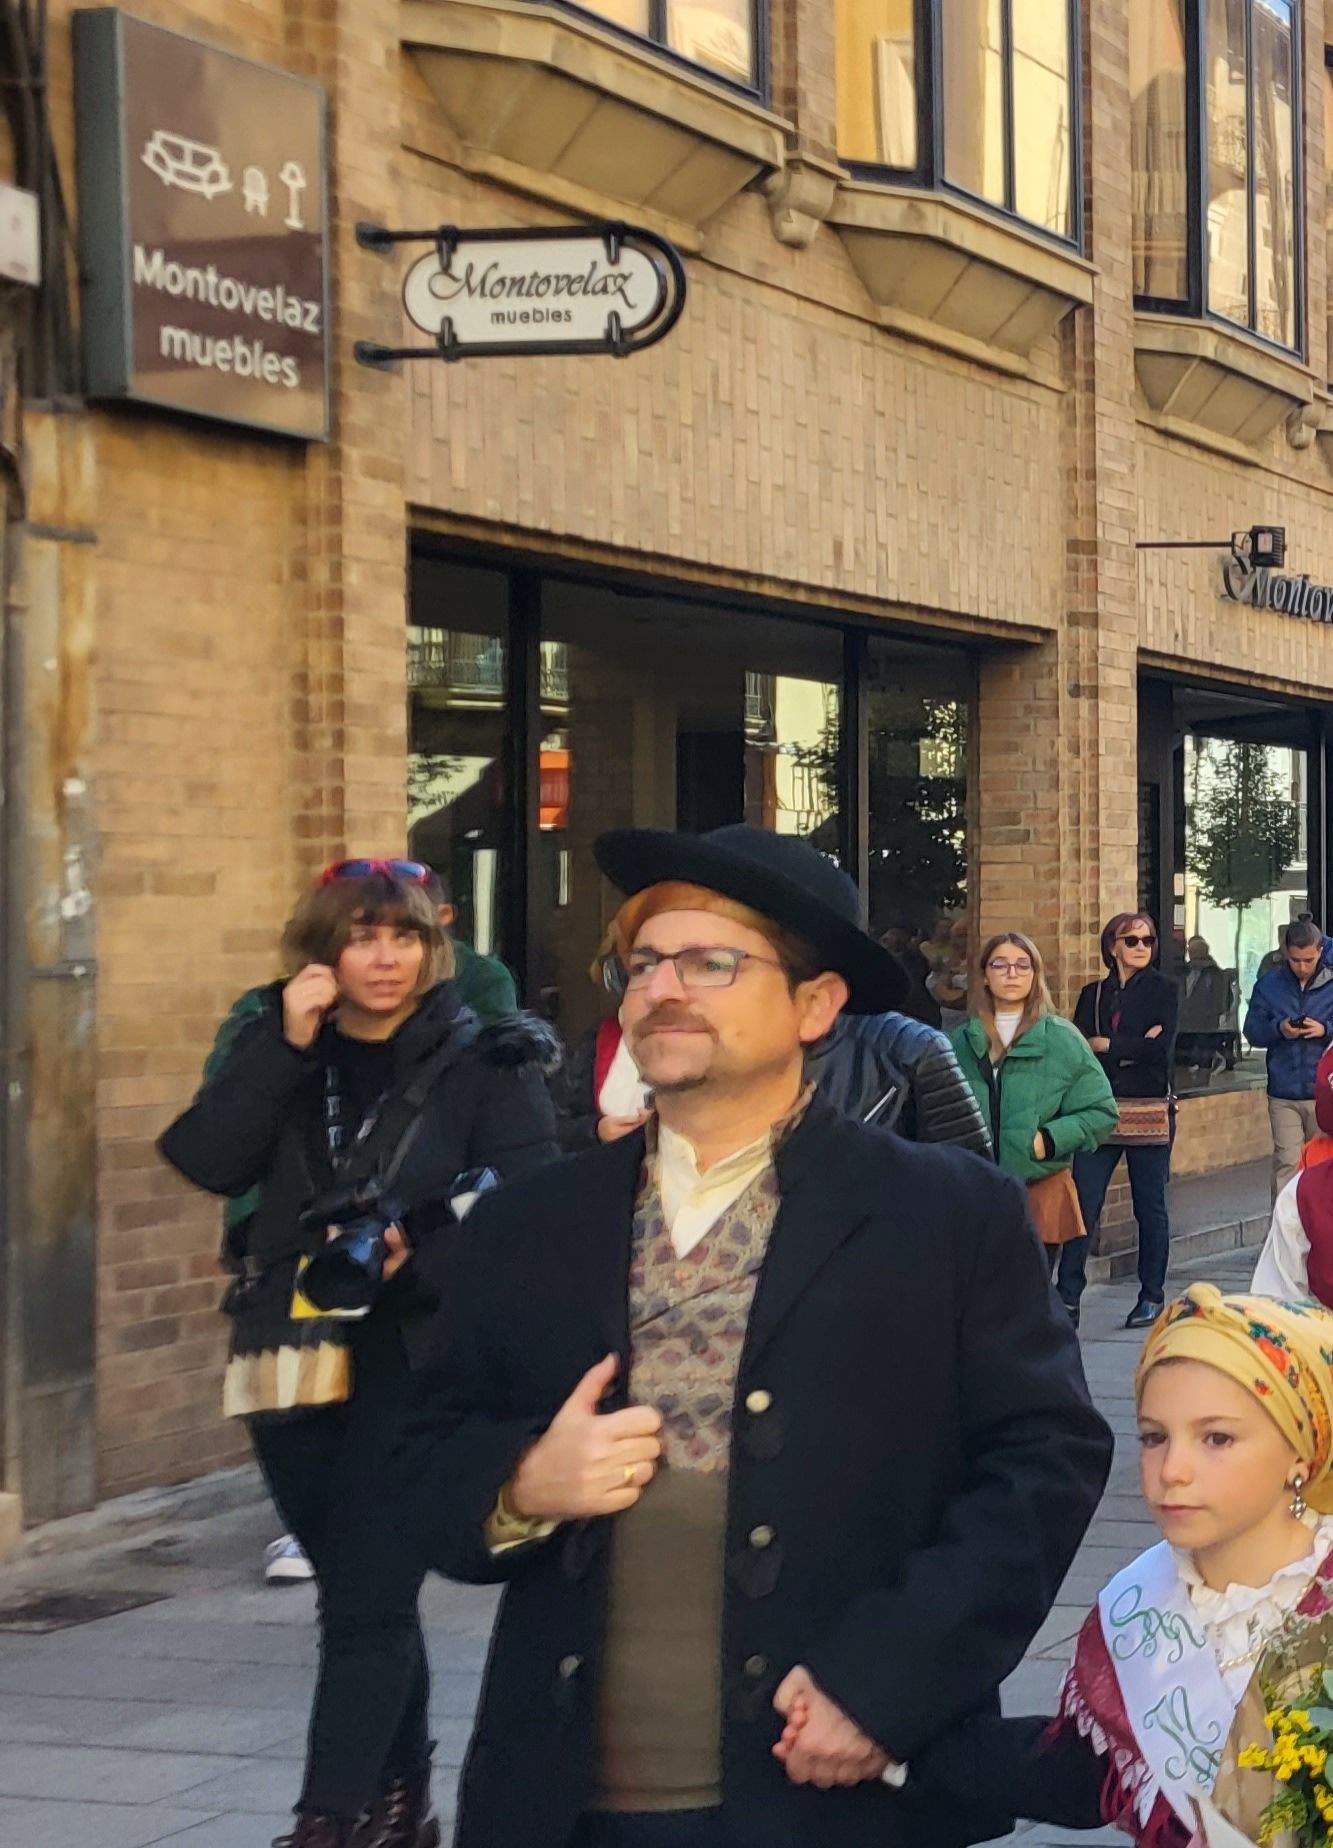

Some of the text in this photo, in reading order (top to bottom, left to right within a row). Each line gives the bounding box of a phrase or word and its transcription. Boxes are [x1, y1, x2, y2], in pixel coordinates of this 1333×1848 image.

[133, 244, 322, 334] Montovelaz
[428, 260, 637, 309] Montovelaz
[490, 308, 572, 324] muebles
[159, 323, 299, 387] muebles
